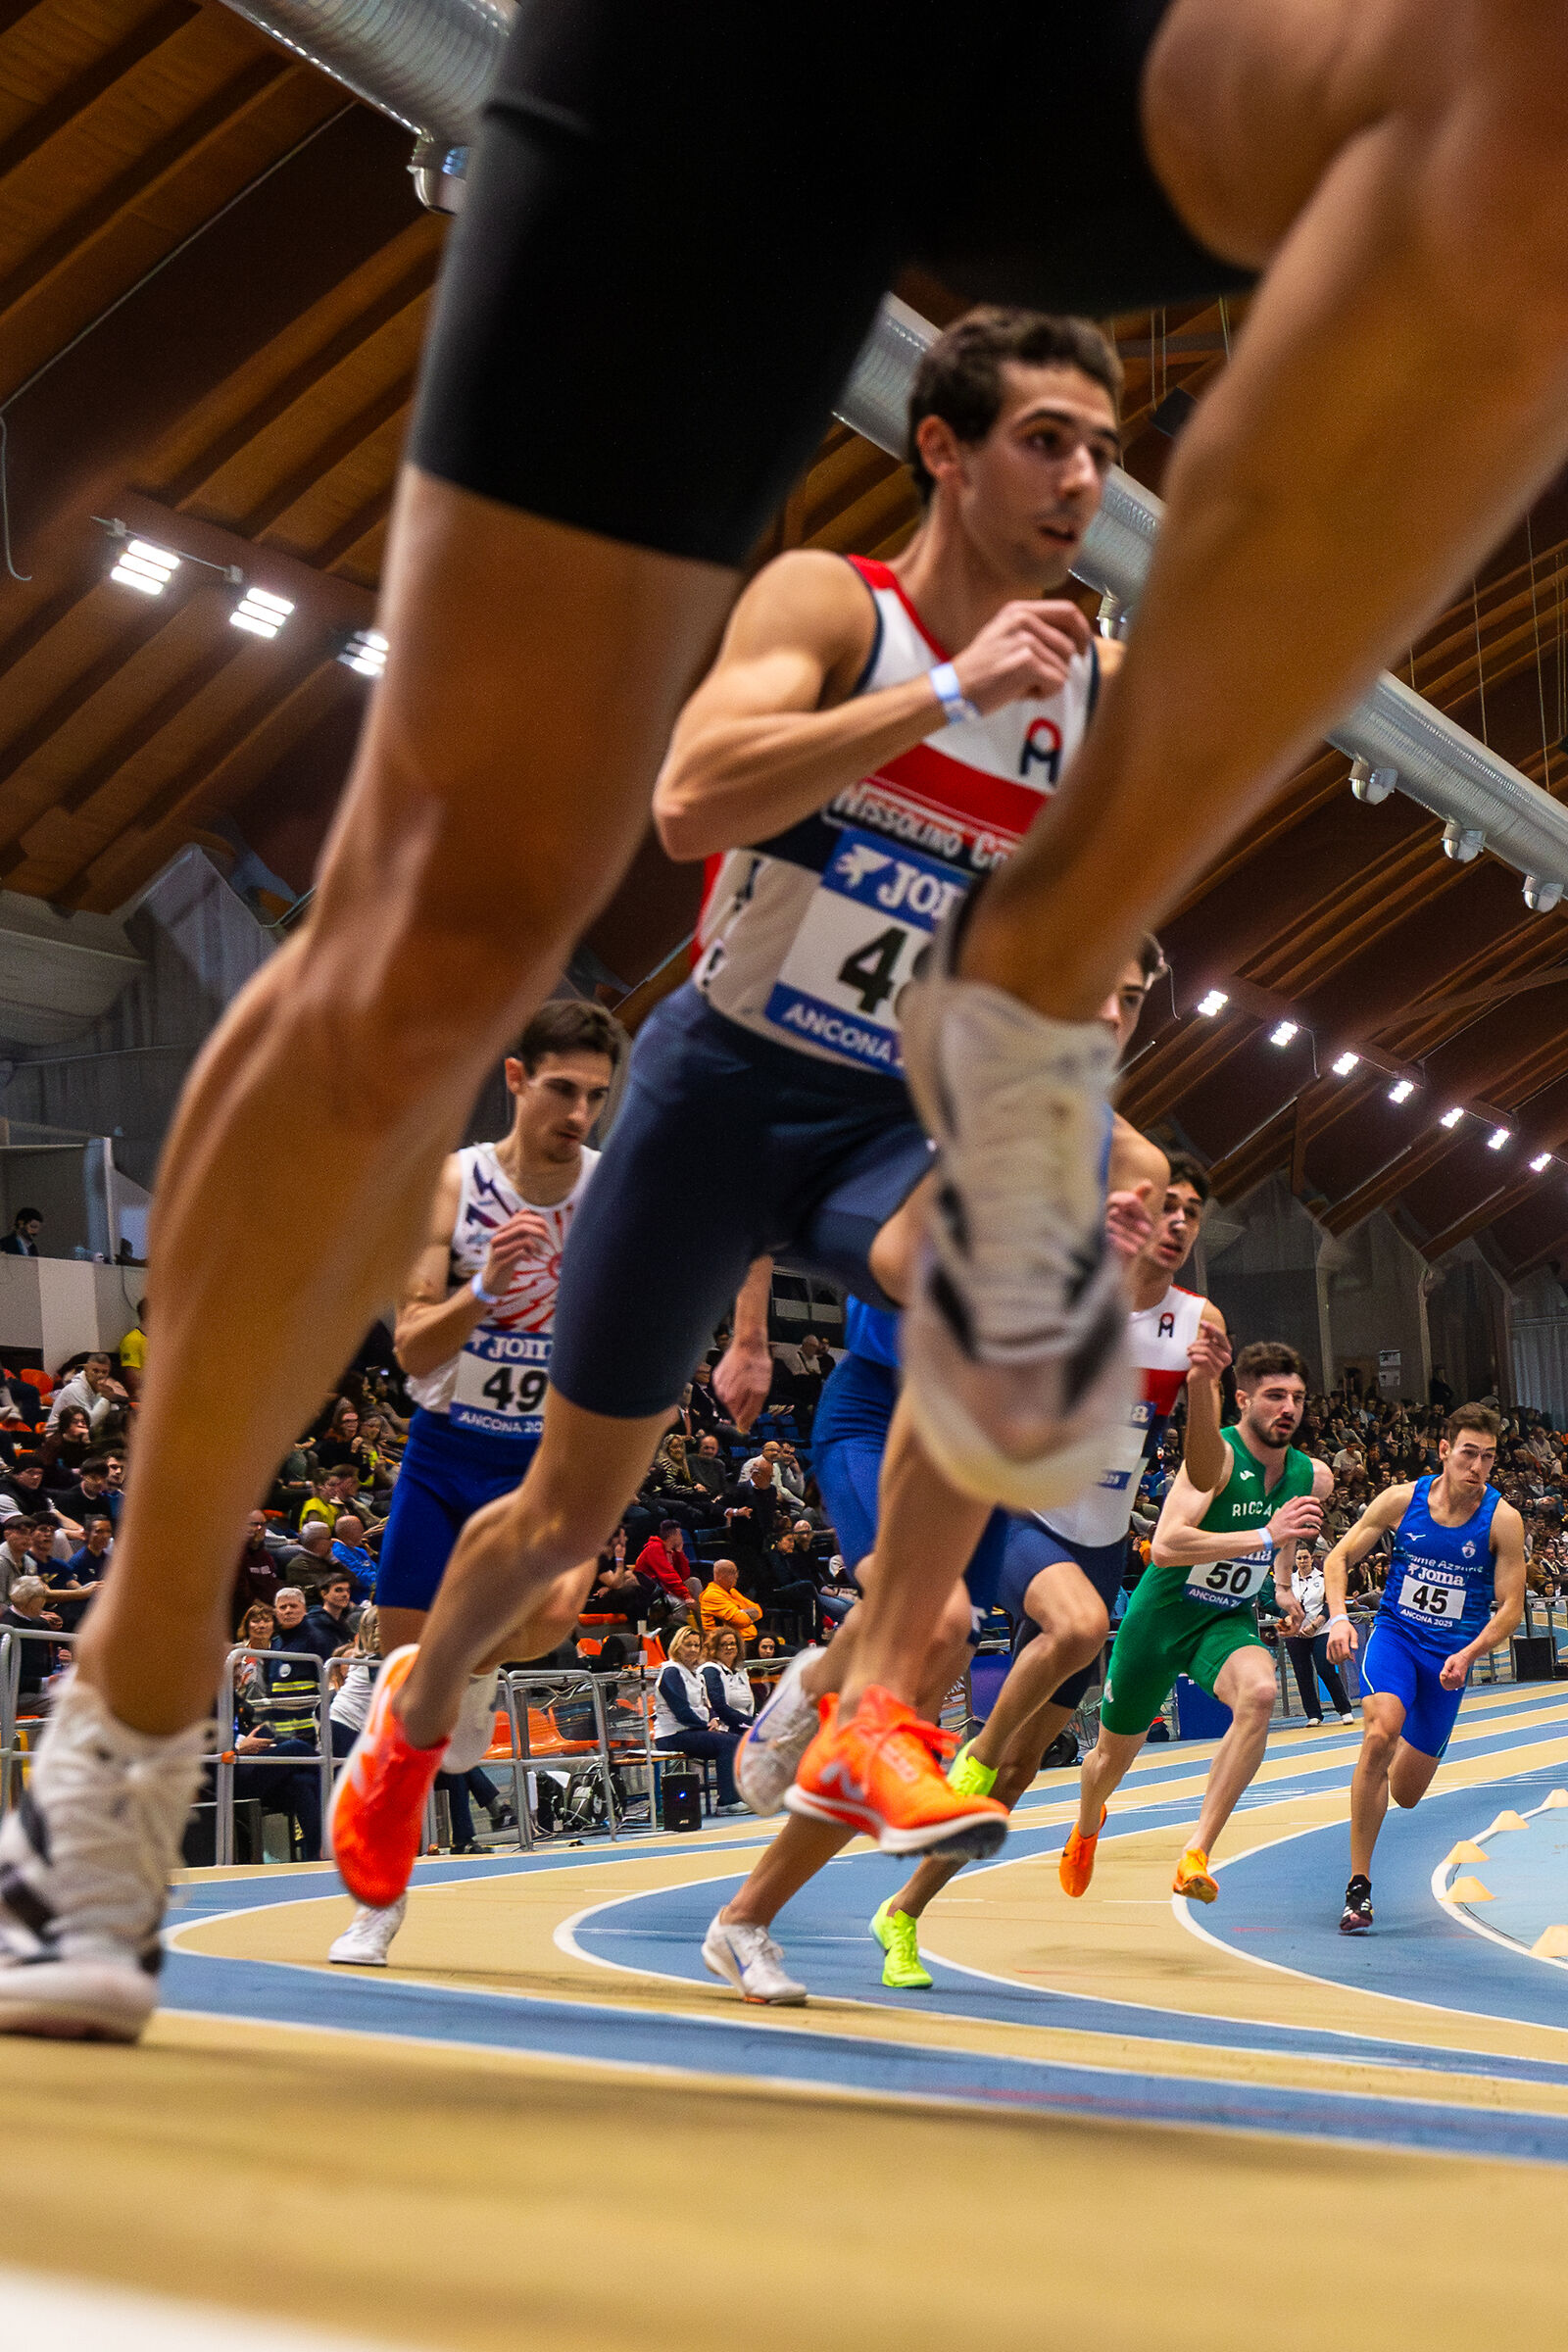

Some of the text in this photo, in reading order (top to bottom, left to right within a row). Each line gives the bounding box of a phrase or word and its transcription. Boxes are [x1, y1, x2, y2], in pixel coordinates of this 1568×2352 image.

[838, 926, 919, 1014] 4
[785, 1003, 893, 1063] ANCONA
[482, 1367, 549, 1412] 49
[458, 1411, 522, 1432] ANCONA
[1232, 1500, 1279, 1518] RICCA
[1205, 1562, 1252, 1594] 50
[1189, 1588, 1231, 1605] ANCONA
[1412, 1585, 1449, 1615] 45
[1400, 1608, 1453, 1628] ANCONA 2025
